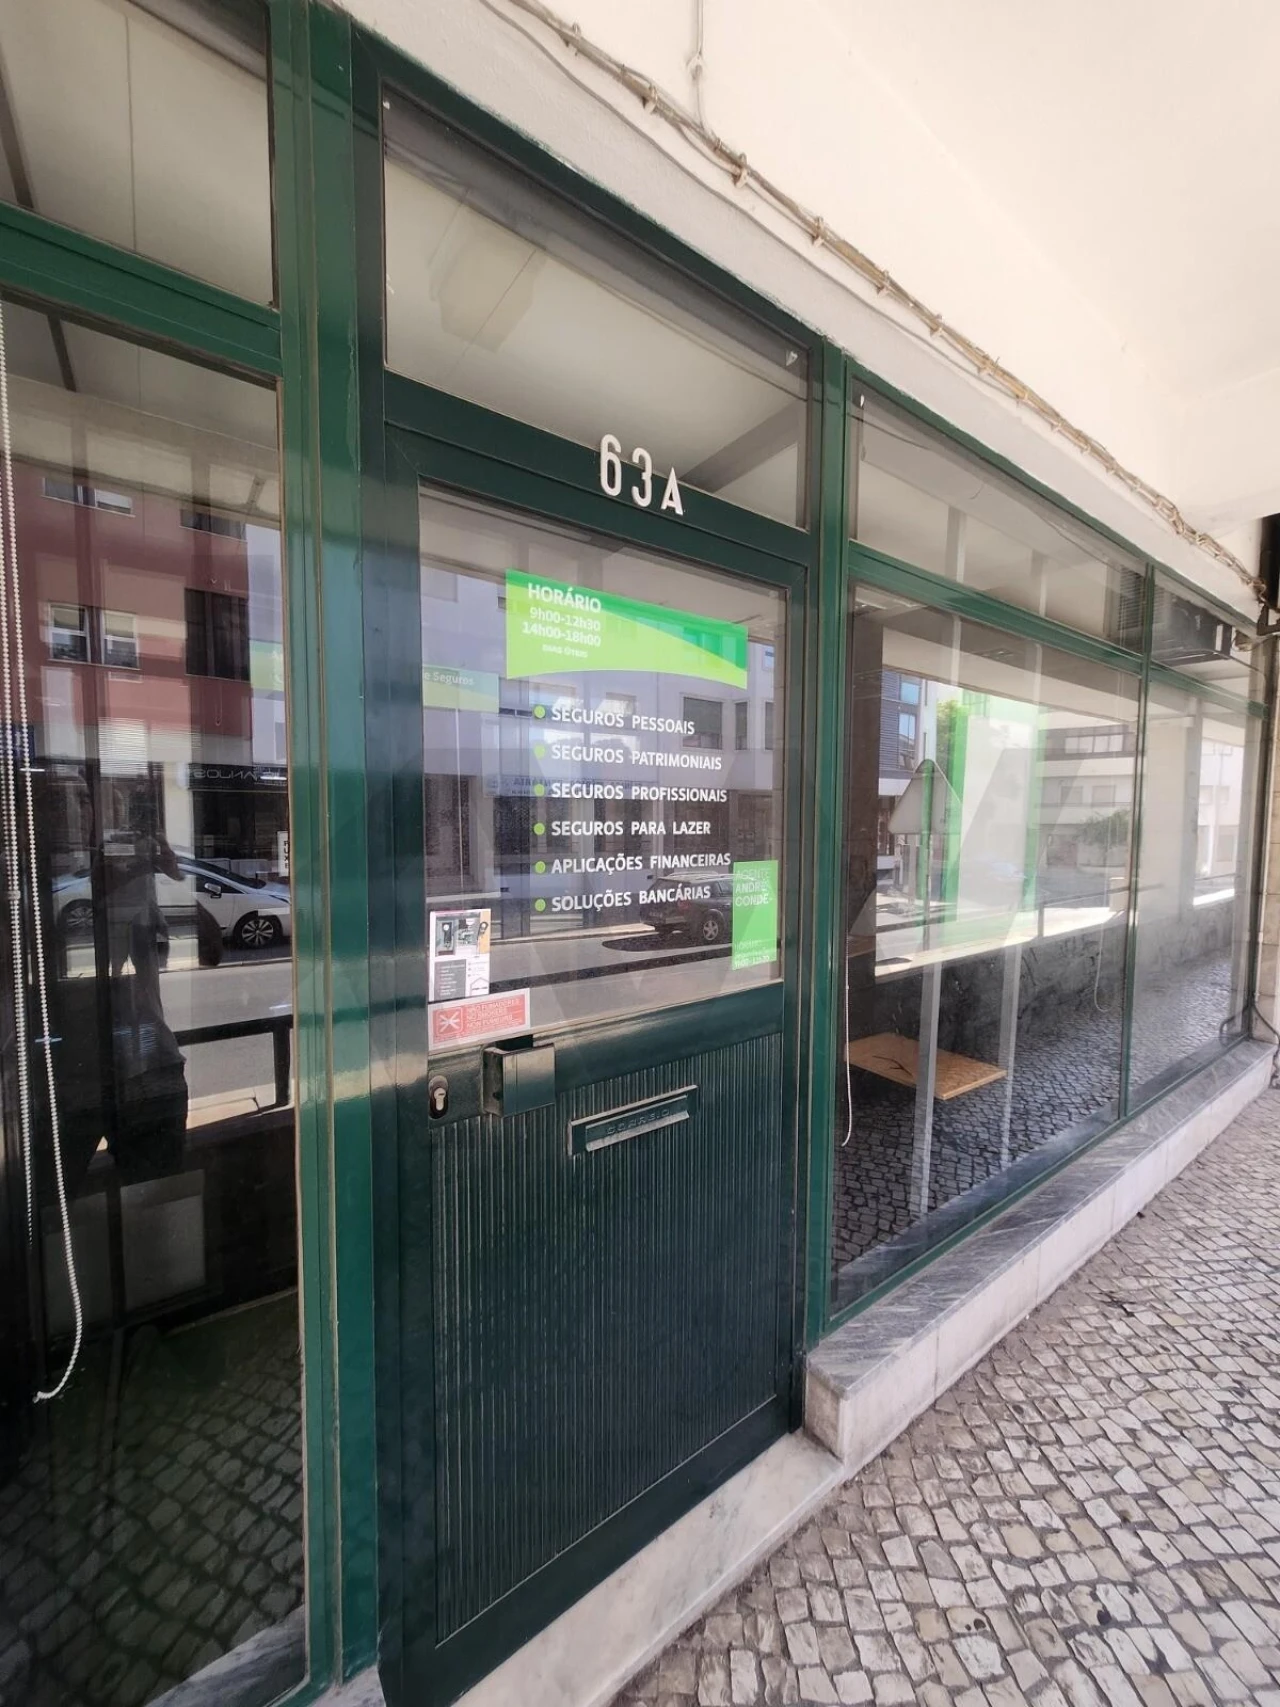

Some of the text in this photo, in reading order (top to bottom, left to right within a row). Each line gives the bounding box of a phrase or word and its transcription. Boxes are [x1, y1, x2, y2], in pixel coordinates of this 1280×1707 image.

[528, 582, 602, 613] HORÁRIO
[529, 606, 601, 632] 9h00-12h30
[522, 621, 602, 648] 14h00-18h00
[433, 672, 474, 686] Seguros
[551, 706, 695, 735] SEGUROS PESSOAIS
[551, 744, 722, 770] SEGUROS PATRIMONIAIS
[551, 782, 624, 800] SEGUROS
[631, 786, 728, 803] PROFISSIONAIS
[551, 821, 711, 836] SEGUROS PARA LAZER
[551, 853, 731, 875] APLICAÇÕES FINANCEIRAS
[551, 883, 711, 912] SOLUÇÕES BANCÁRIAS
[735, 893, 769, 906] CONDE
